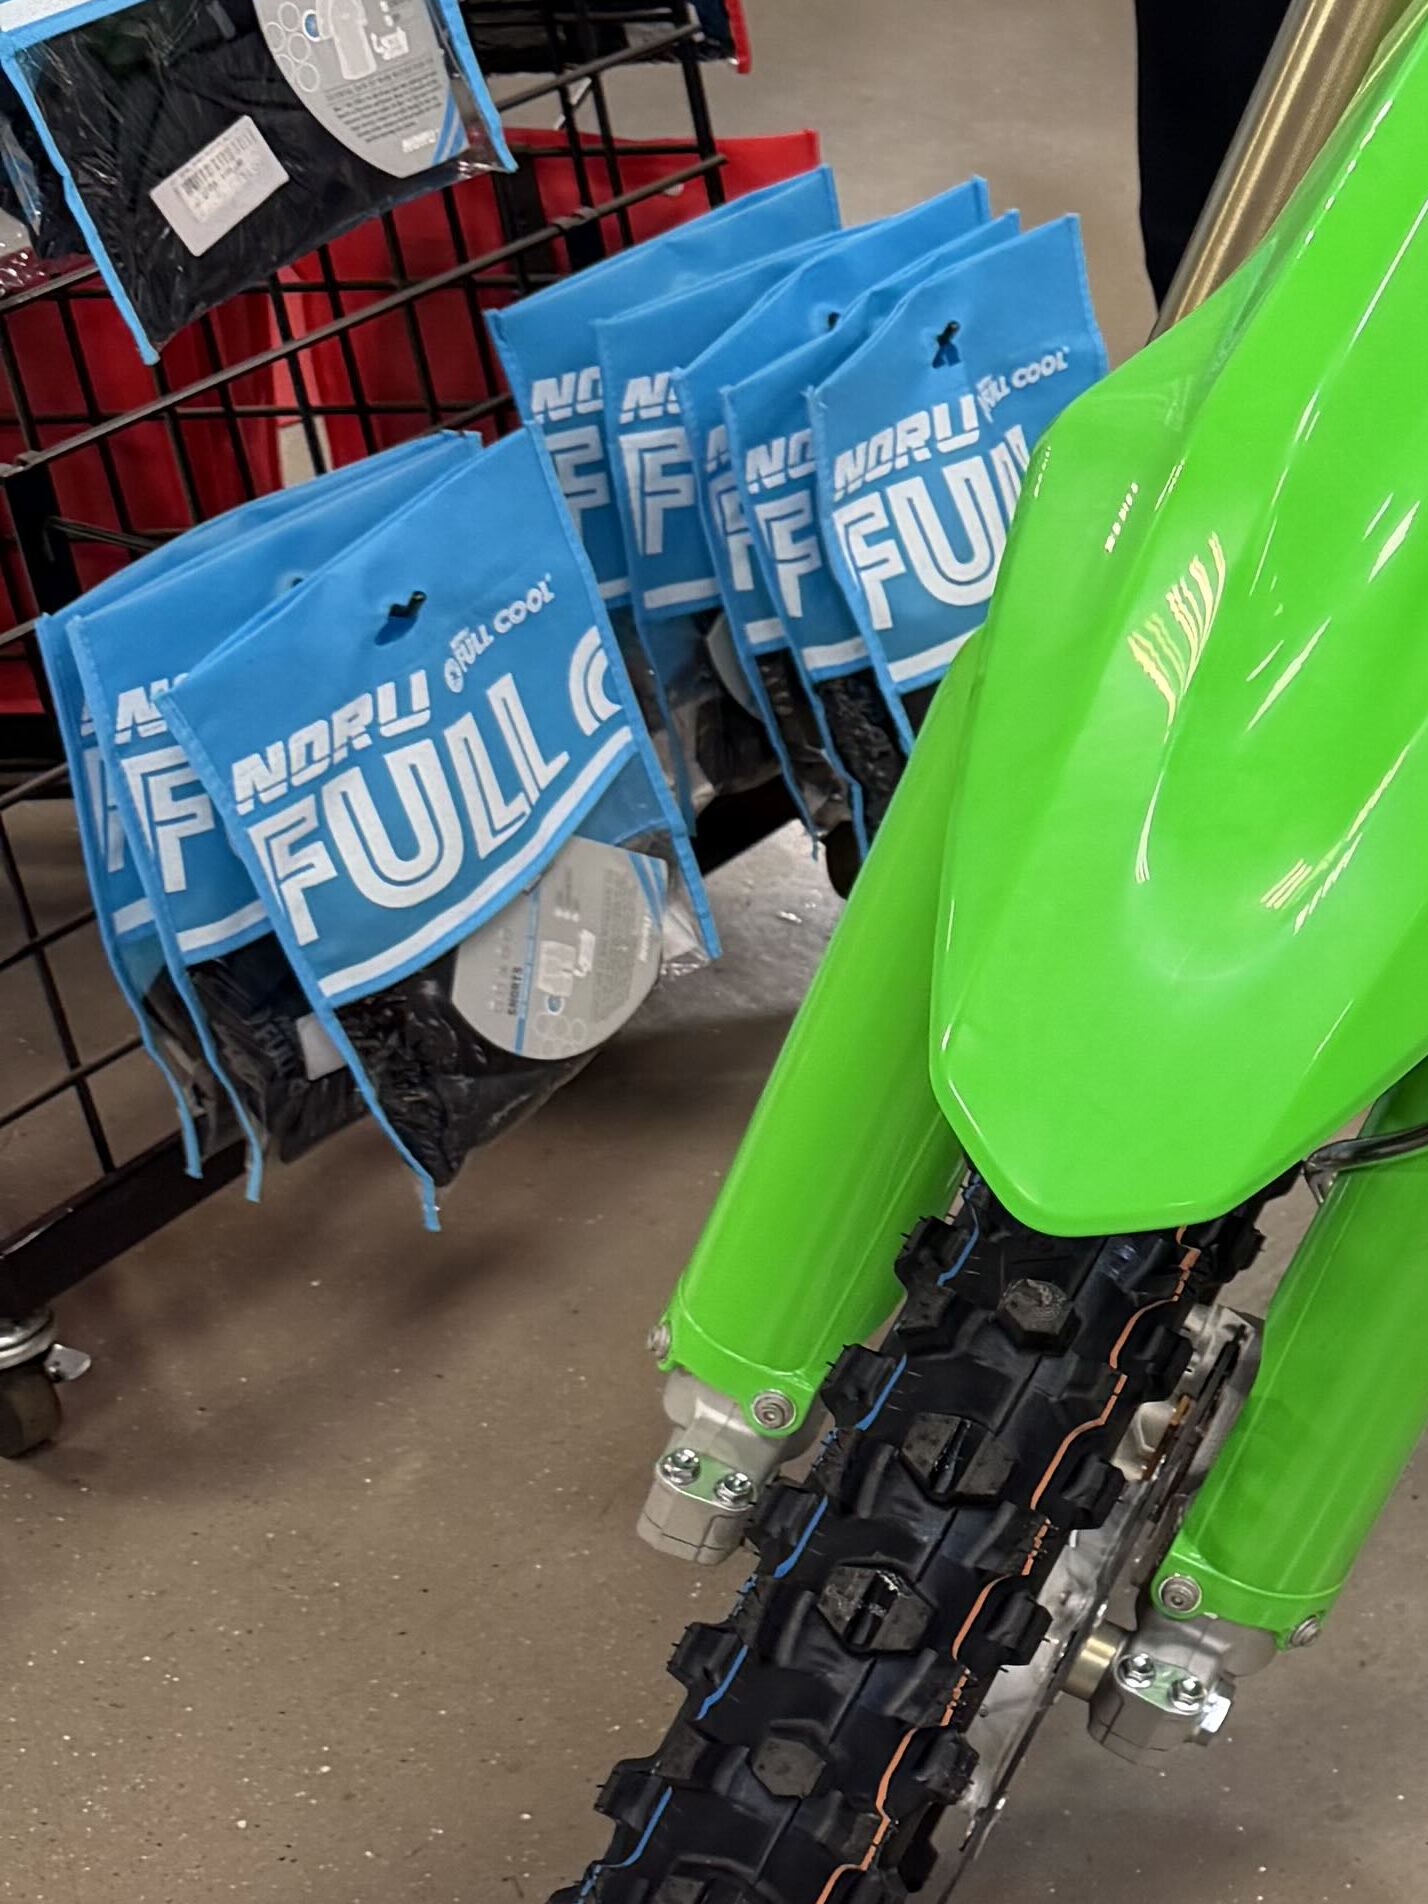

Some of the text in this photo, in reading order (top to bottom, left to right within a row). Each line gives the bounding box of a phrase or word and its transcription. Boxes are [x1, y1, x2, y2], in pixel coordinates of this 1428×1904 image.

[1012, 351, 1068, 388] COOL
[834, 393, 980, 502] NORU
[494, 581, 555, 633] COOL
[231, 668, 431, 815] NORU
[247, 673, 570, 946] FULL
